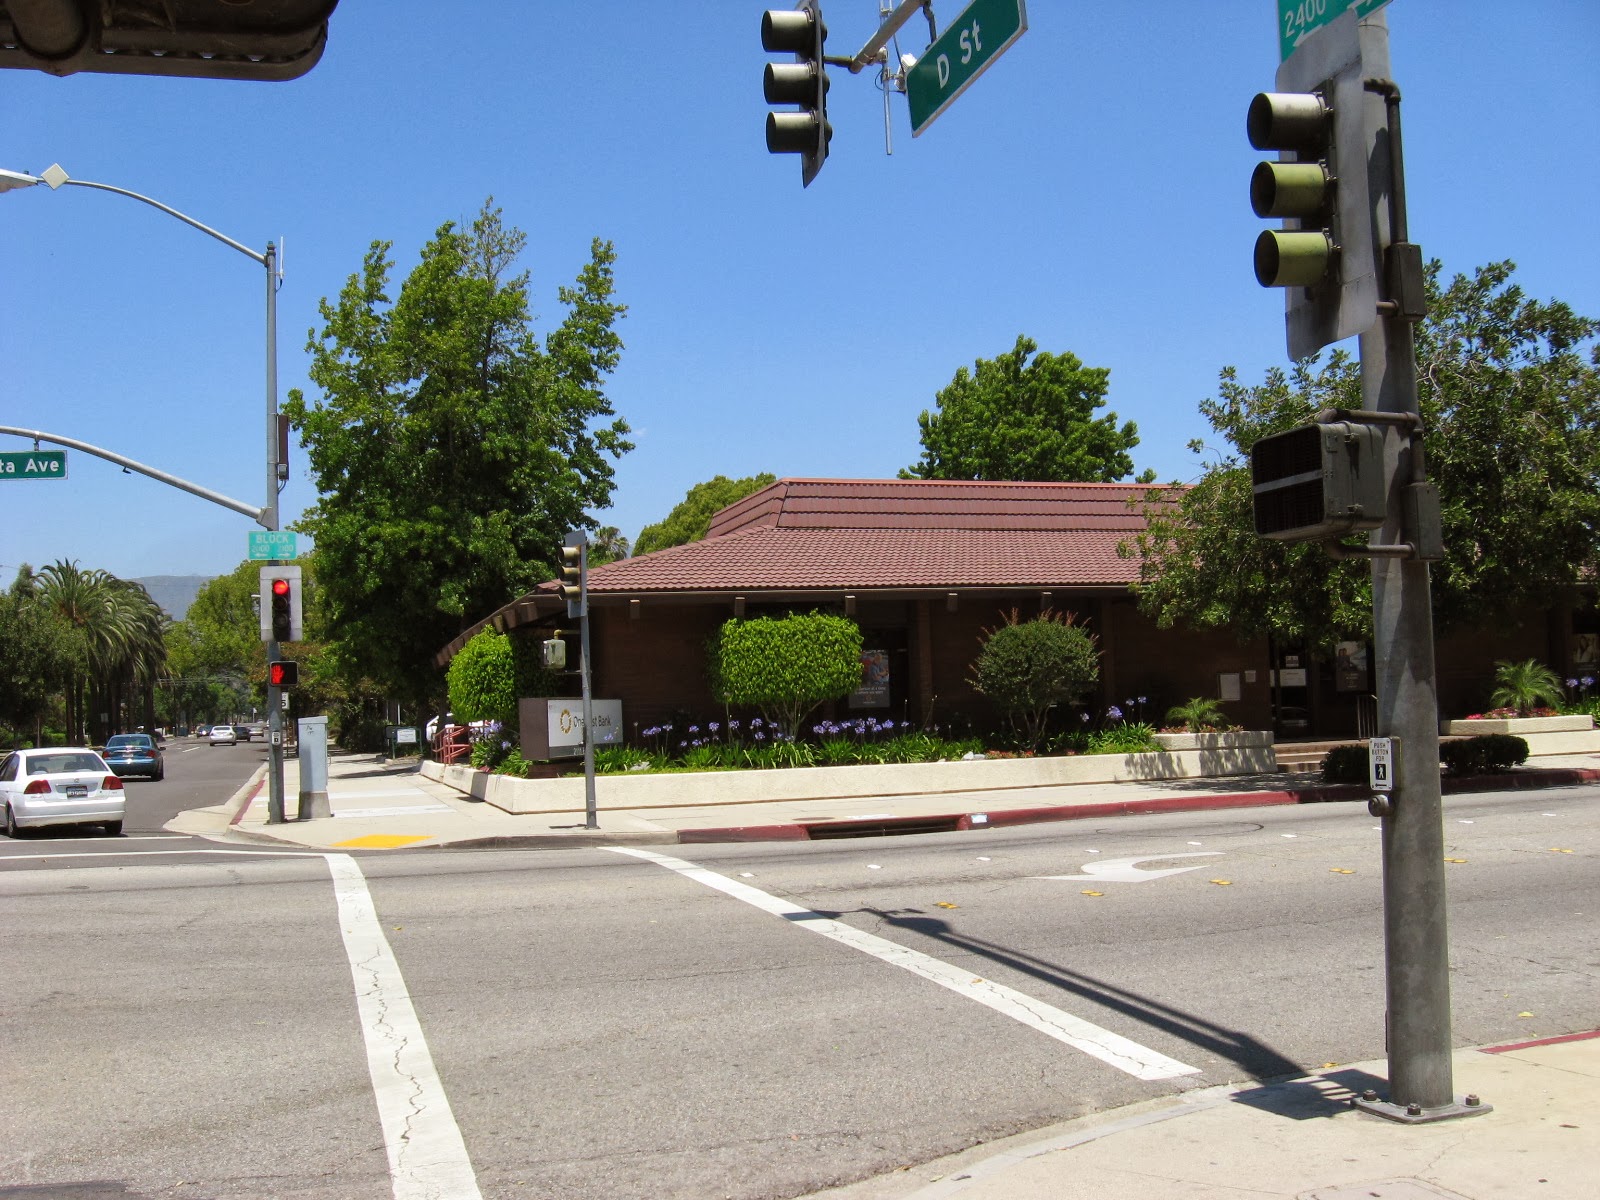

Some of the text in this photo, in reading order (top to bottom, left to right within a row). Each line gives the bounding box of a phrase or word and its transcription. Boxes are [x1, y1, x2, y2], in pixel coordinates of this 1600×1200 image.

[1284, 0, 1326, 38] 2400
[937, 18, 982, 89] D St
[24, 458, 60, 473] Ave
[256, 534, 289, 544] BLOCK
[598, 715, 612, 727] Bank
